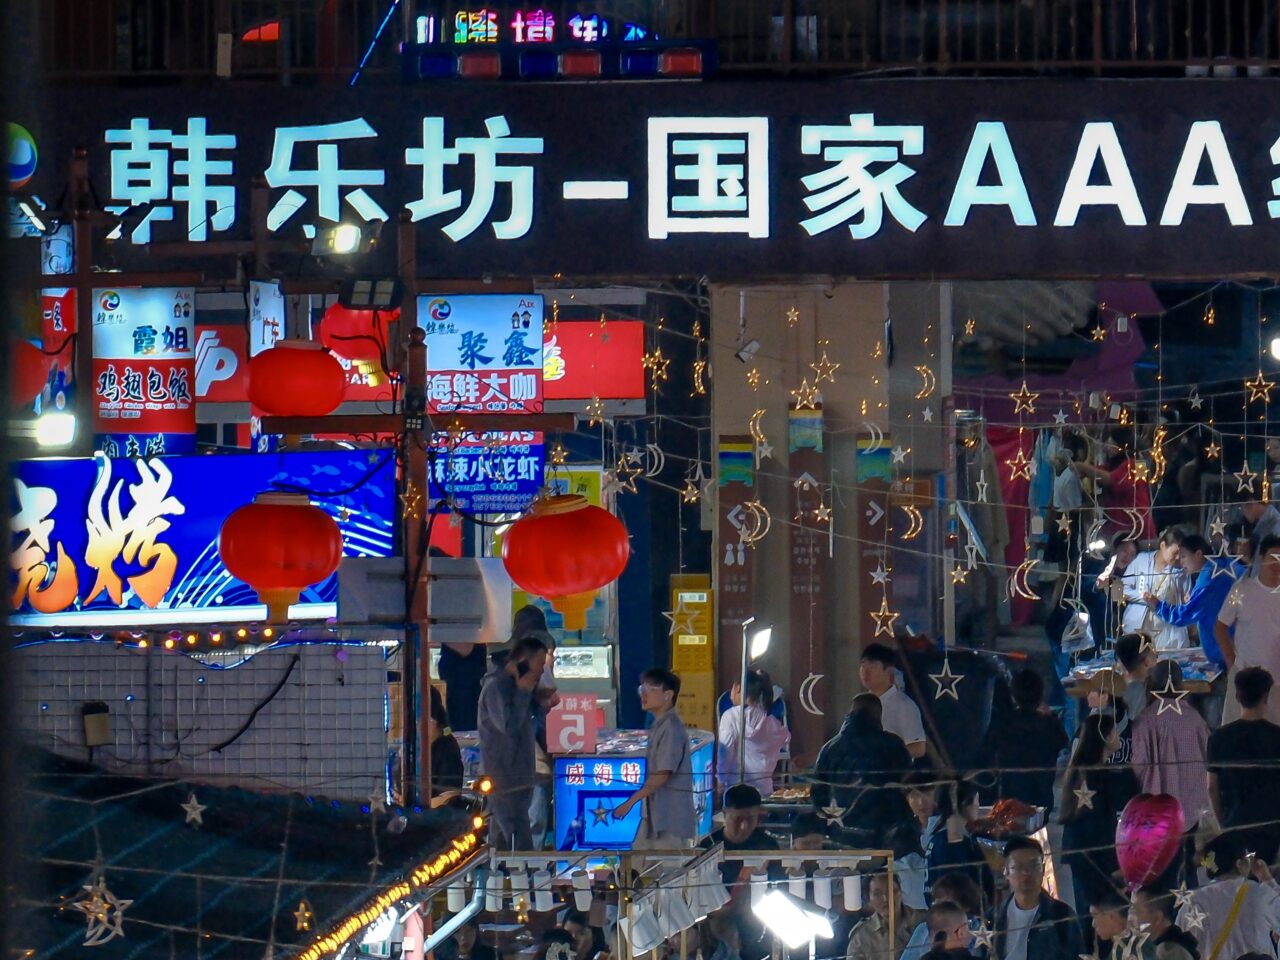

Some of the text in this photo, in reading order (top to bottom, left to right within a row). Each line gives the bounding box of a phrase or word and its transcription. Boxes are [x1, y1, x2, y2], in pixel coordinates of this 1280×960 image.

[458, 330, 540, 370] 聚鑫
[96, 363, 192, 402] 鸡翅包饭
[427, 373, 537, 403] 海鲜大咖
